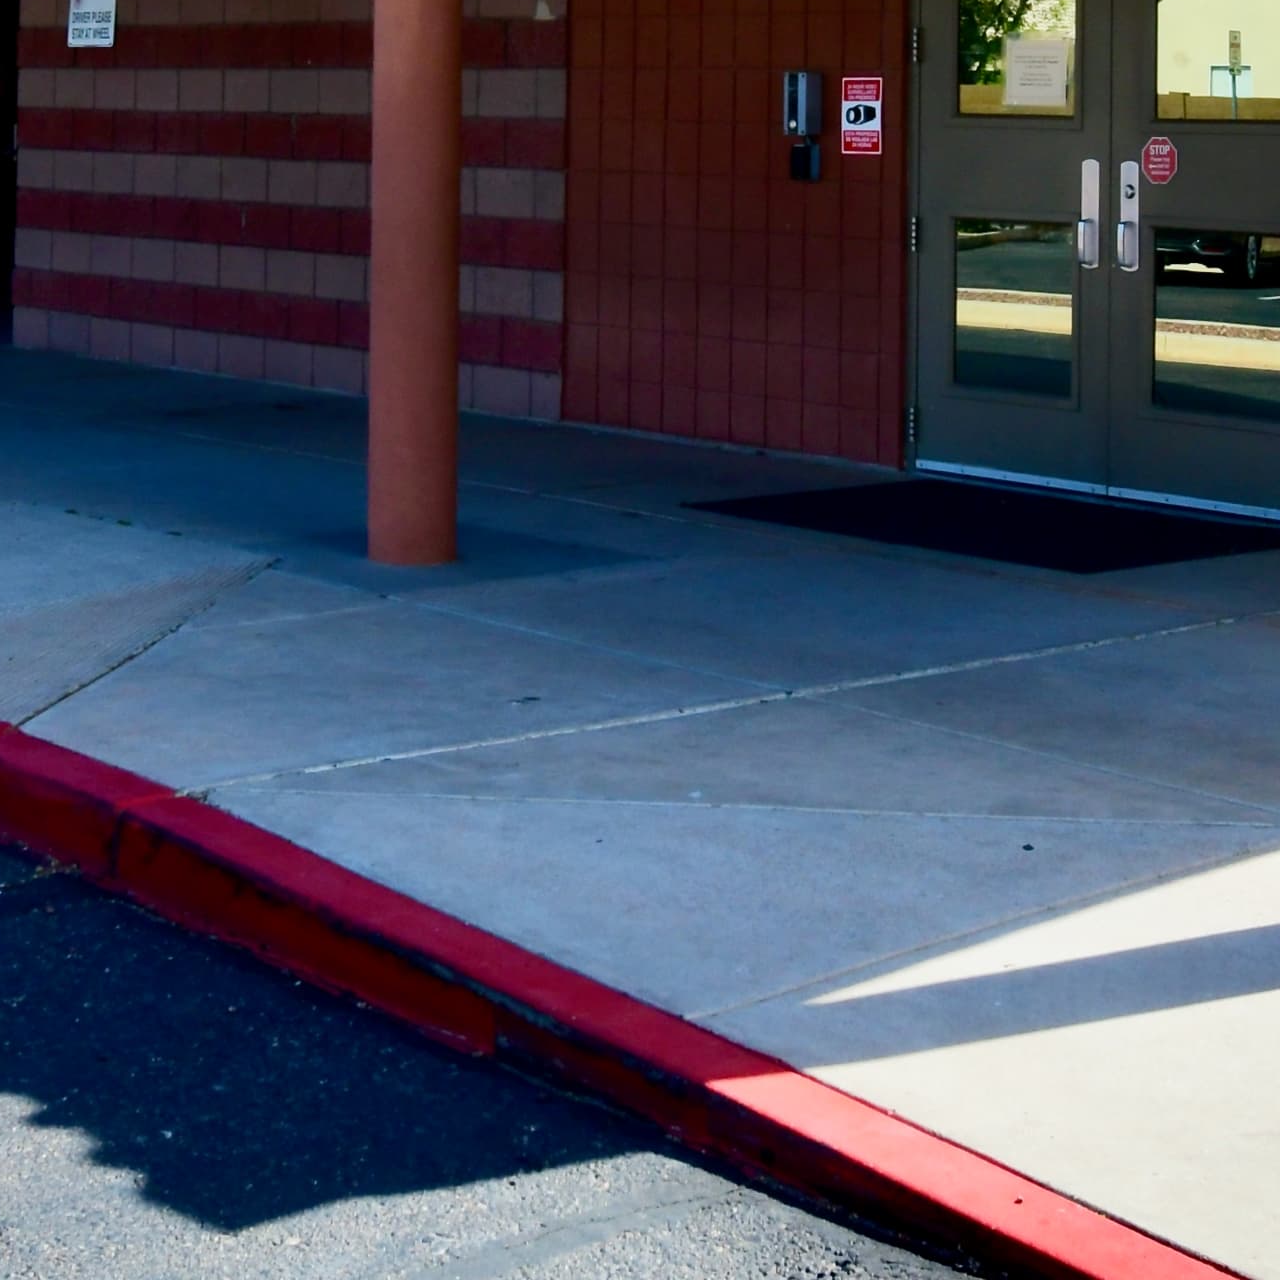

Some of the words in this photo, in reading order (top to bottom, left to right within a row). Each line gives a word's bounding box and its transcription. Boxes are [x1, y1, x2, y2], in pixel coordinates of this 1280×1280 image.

[91, 11, 112, 24] PLEASE
[71, 27, 84, 40] STAY
[85, 27, 92, 39] AT
[93, 27, 110, 39] WHEEL
[1149, 144, 1170, 155] STOP
